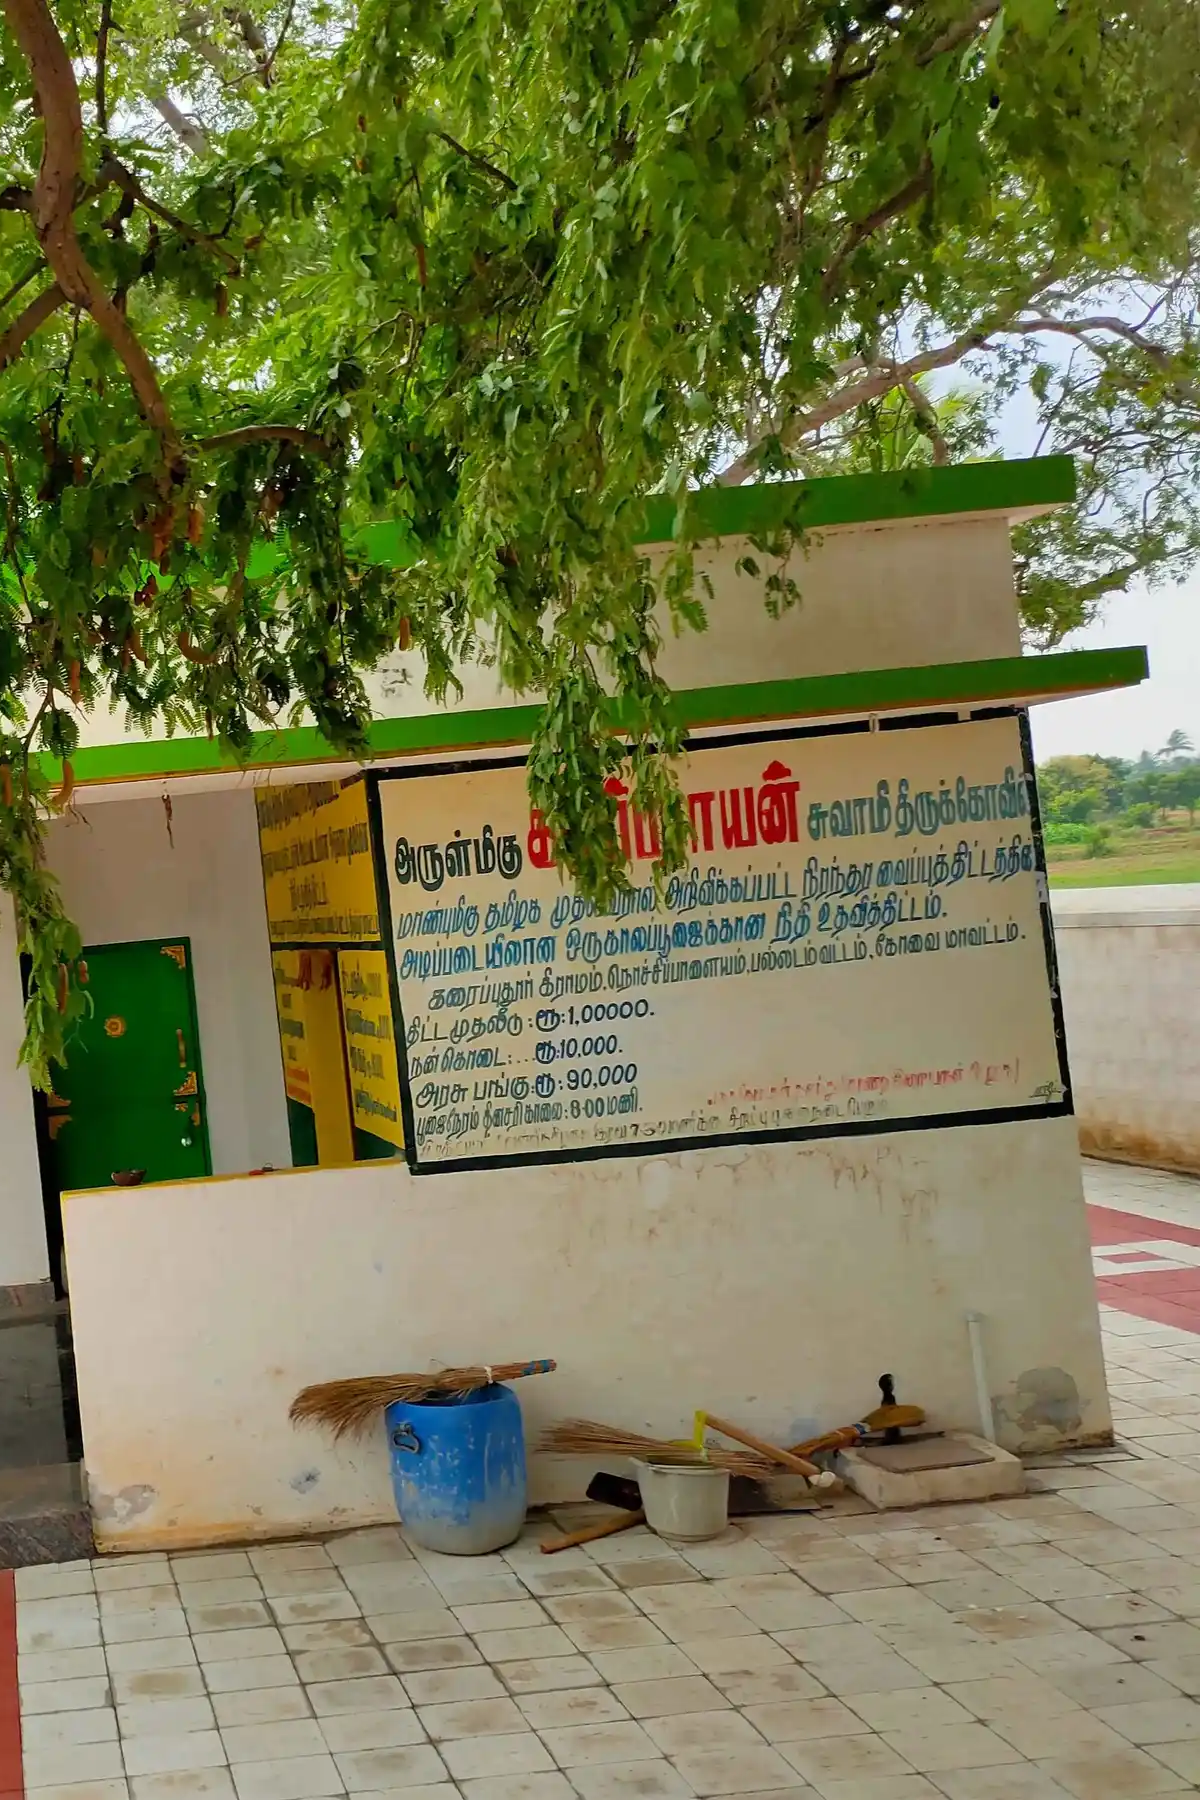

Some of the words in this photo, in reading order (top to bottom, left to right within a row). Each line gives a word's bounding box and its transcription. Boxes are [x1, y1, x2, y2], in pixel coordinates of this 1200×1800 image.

[395, 824, 522, 891] அருள்மிகு
[770, 900, 810, 944] நிதி
[415, 1081, 468, 1111] அரசு
